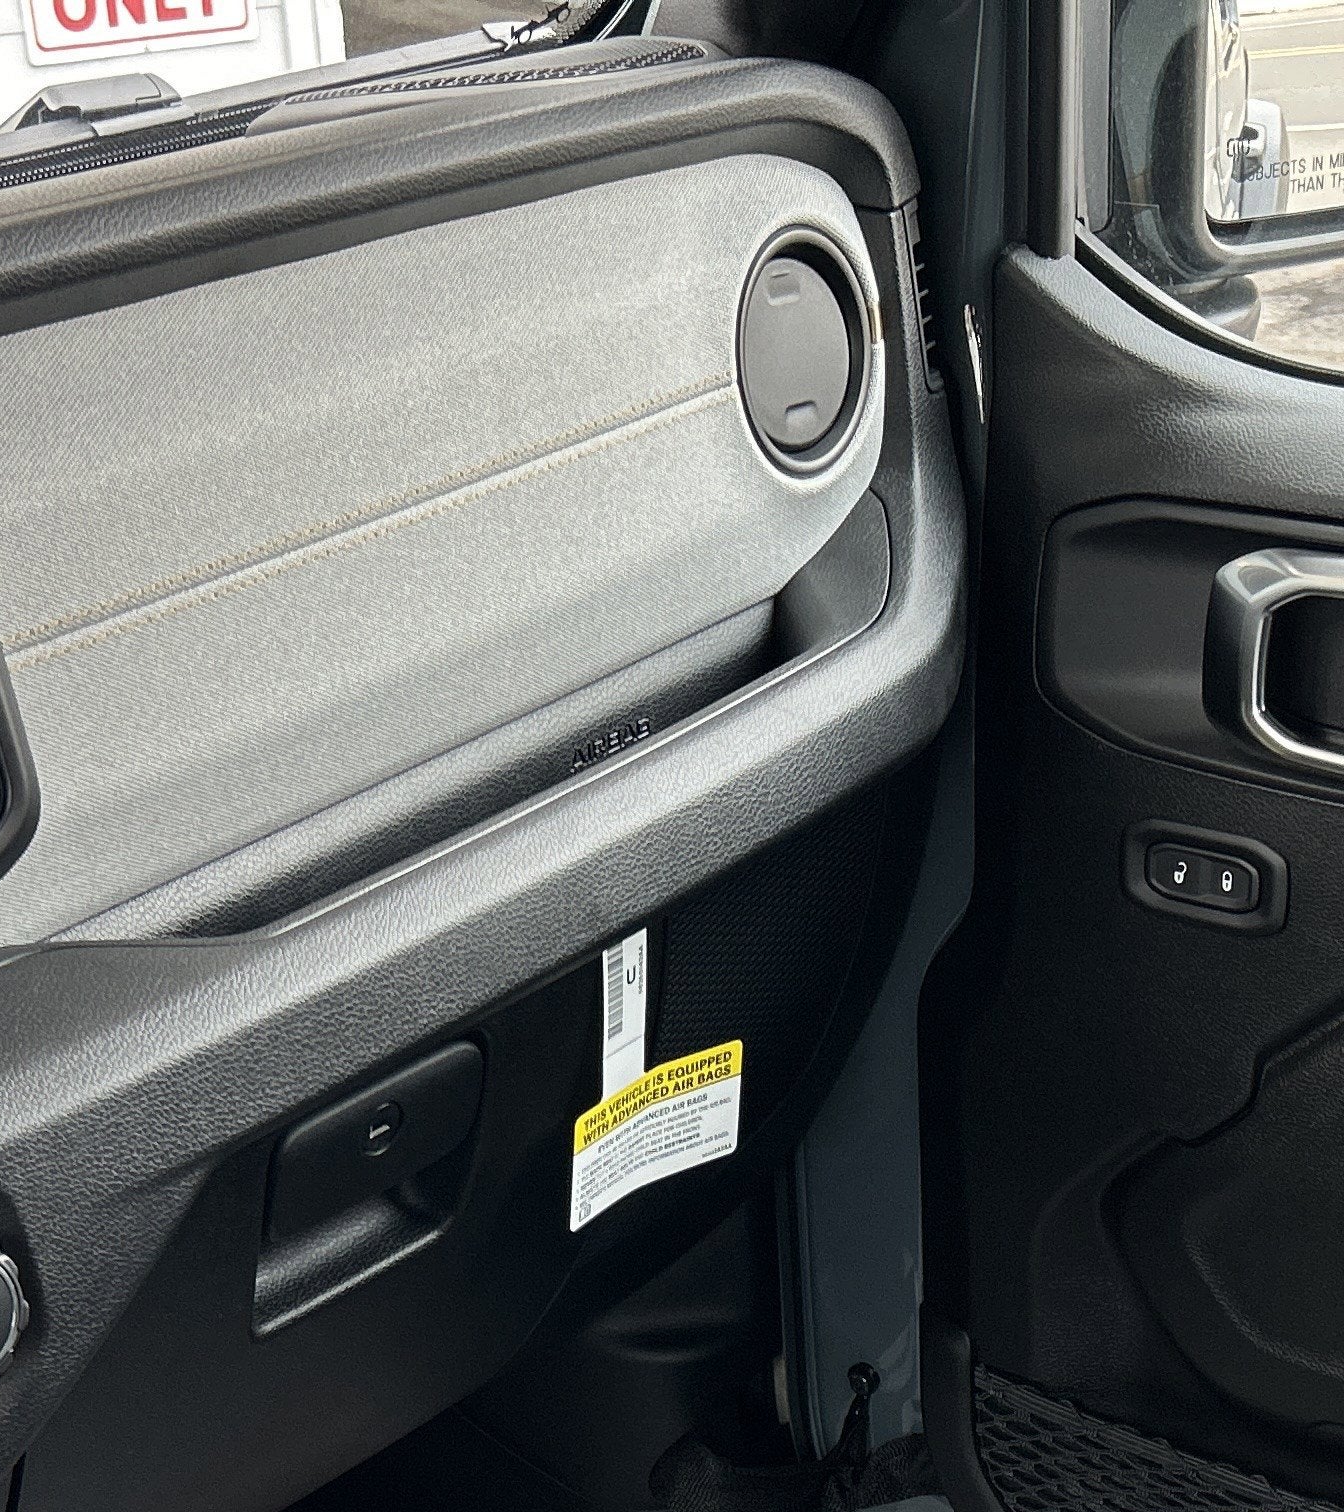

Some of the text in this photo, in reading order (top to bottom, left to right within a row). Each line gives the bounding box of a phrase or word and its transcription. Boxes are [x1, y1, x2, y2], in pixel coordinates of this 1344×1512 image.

[54, 0, 213, 31] ON
[1312, 157, 1324, 170] IN
[1290, 174, 1324, 194] THAN
[584, 1050, 733, 1132] THIS VEHICLE IS EQUIPPED
[583, 1064, 731, 1146] WITH ADVANCED AIR BAGS
[672, 1100, 686, 1113] AIR
